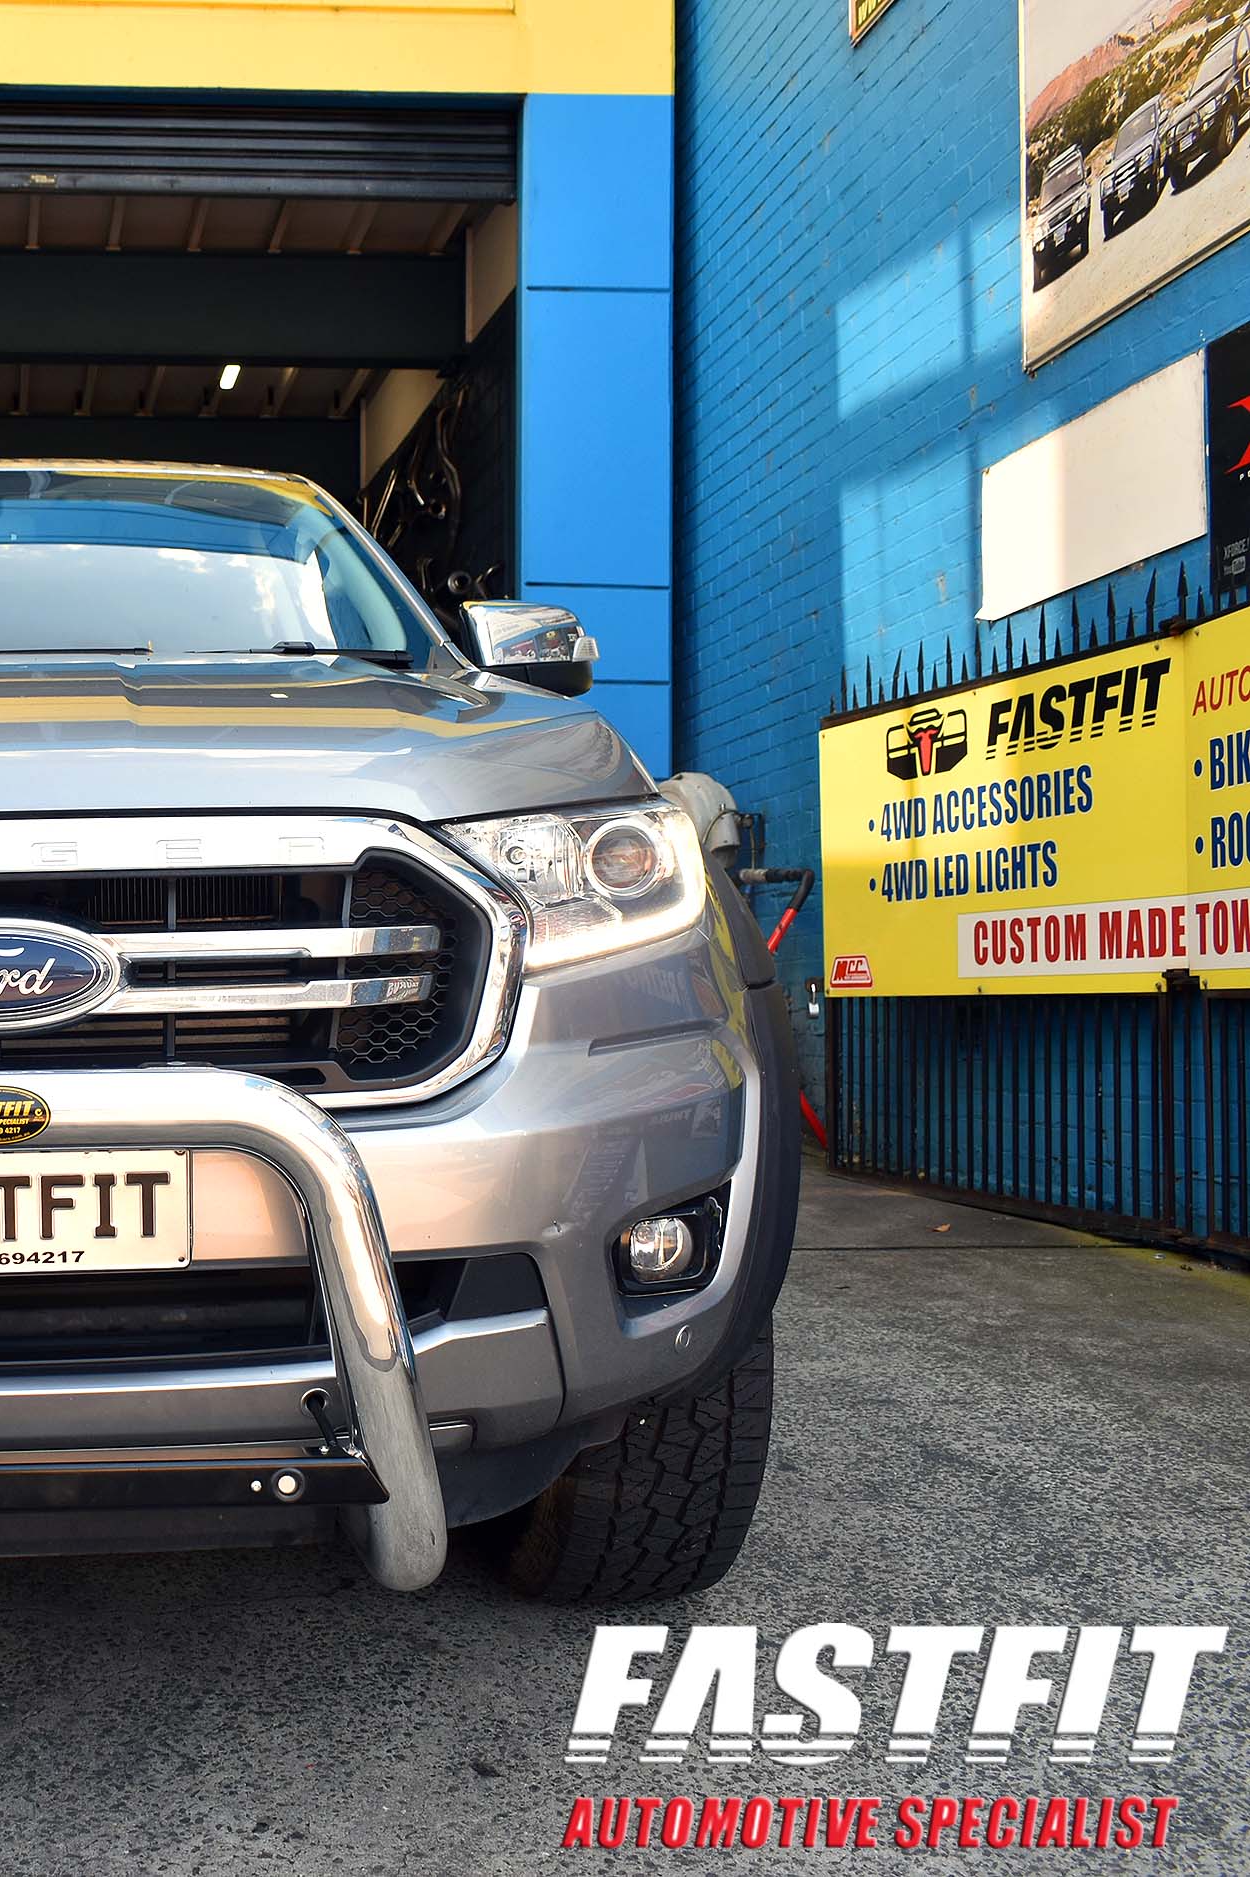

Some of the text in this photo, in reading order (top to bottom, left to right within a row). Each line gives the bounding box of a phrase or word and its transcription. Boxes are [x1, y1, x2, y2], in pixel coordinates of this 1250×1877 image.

[985, 657, 1172, 761] FASTFIT
[880, 765, 1093, 842] 4WD ACCESSORIES
[882, 841, 1058, 902] 4WD LED LIGHTS
[973, 914, 1087, 966] CUSTOM
[1099, 906, 1186, 961] MADE
